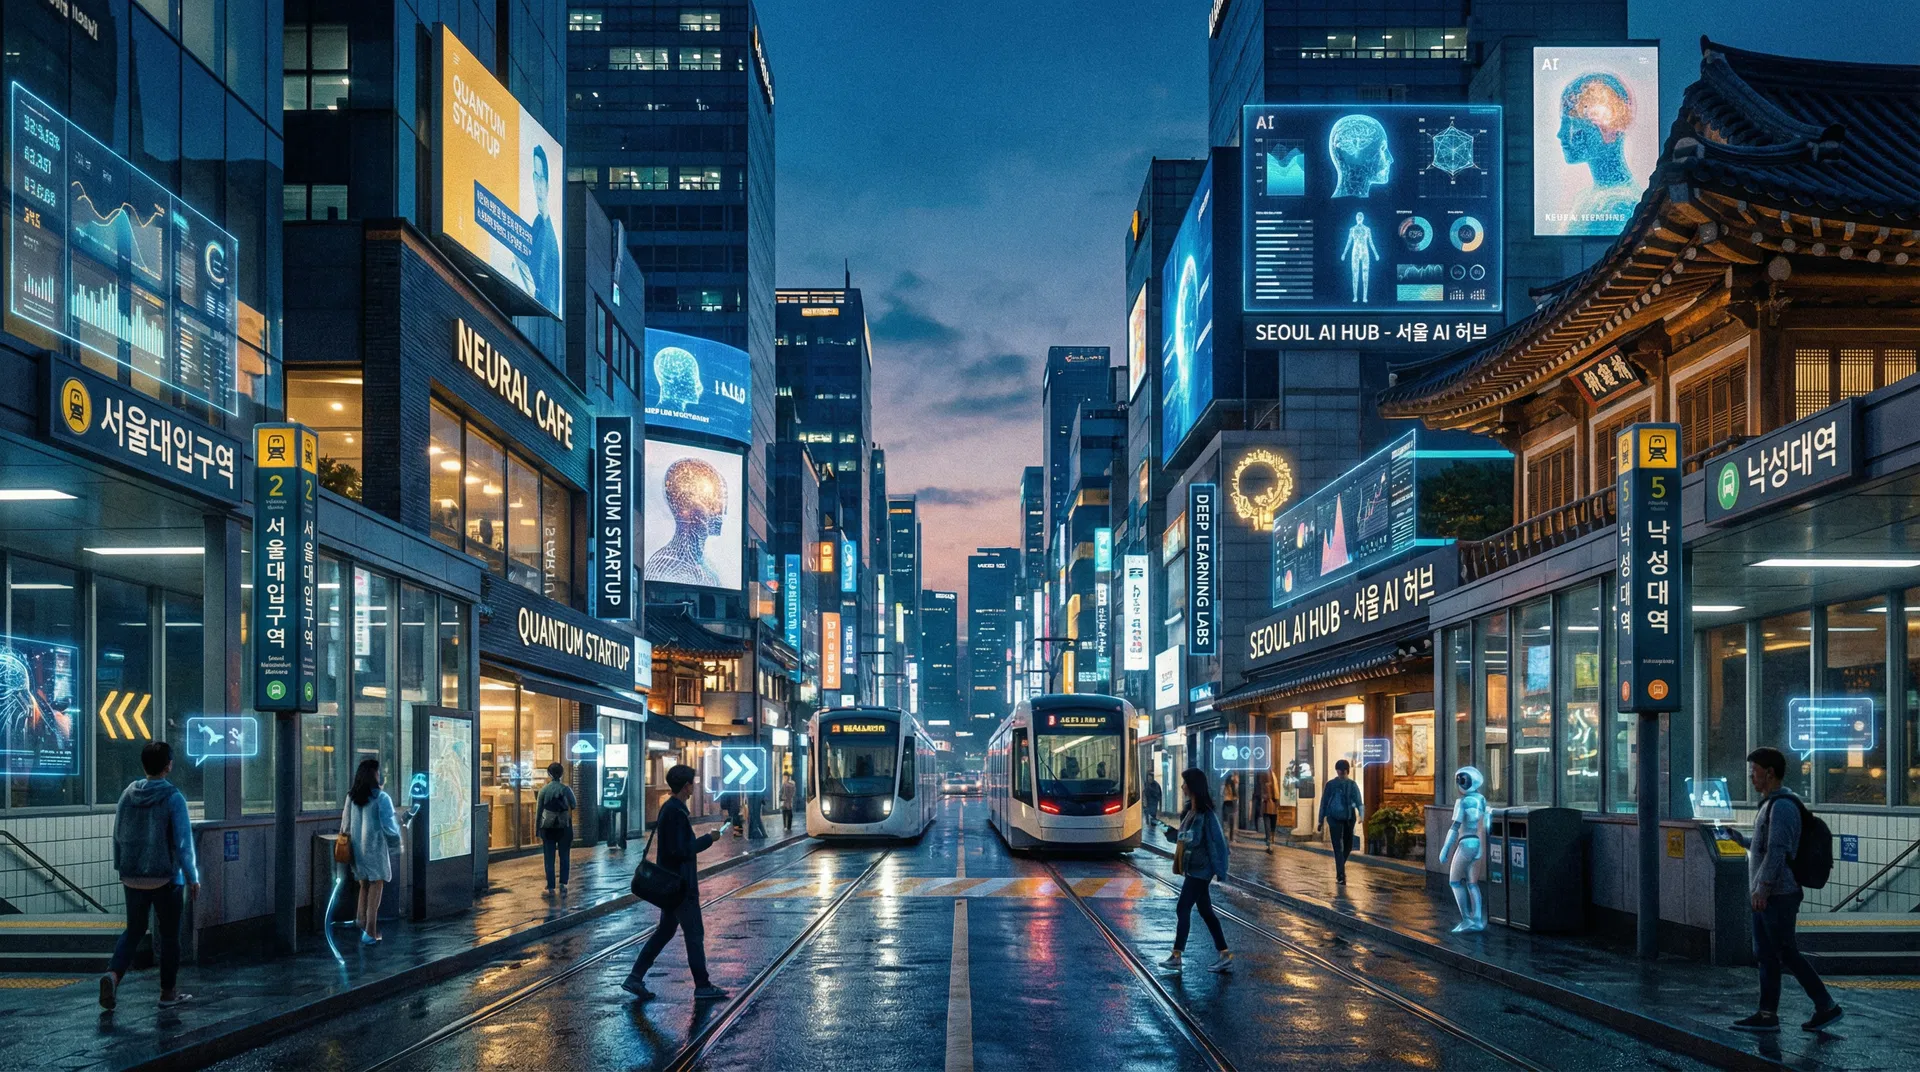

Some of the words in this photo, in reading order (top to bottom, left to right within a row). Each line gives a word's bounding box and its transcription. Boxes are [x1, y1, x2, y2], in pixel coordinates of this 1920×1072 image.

[1542, 58, 1560, 71] AI
[452, 101, 500, 160] STARTUP
[453, 75, 506, 141] QUANTUM
[1256, 115, 1275, 130] AI
[1256, 324, 1314, 341] SEOUL
[1319, 324, 1336, 341] AI
[1341, 324, 1380, 341] HUB
[1396, 322, 1430, 343] 서울
[1433, 324, 1450, 341] AI
[1456, 322, 1487, 343] 허브
[458, 317, 533, 419] NEURAL
[535, 389, 574, 451] CAFE
[101, 397, 234, 490] 서울대입구역
[603, 430, 622, 520] QUANTUM
[1748, 421, 1836, 494] 낙성대역
[269, 475, 283, 496] 2
[305, 479, 313, 501] 2
[1197, 494, 1210, 531] DEEP
[1623, 480, 1630, 502] 5
[1651, 476, 1666, 499] 5
[266, 516, 287, 649] 서울대입구역
[303, 520, 314, 650] 서울대입구역
[604, 526, 622, 606] STARTUP
[1197, 535, 1210, 608] LEARNING
[1620, 521, 1631, 635] 낙성대역
[1646, 520, 1670, 634] 낙성대역
[518, 607, 583, 658] QUANTUM
[585, 632, 630, 671] STARTUP
[1197, 611, 1210, 646] LABS
[1250, 619, 1290, 660] SEOUL
[1293, 612, 1306, 645] AI
[1309, 600, 1340, 639] HUB
[1353, 584, 1380, 623] 서울
[1383, 577, 1399, 614] AI
[1403, 563, 1435, 608] 허브
